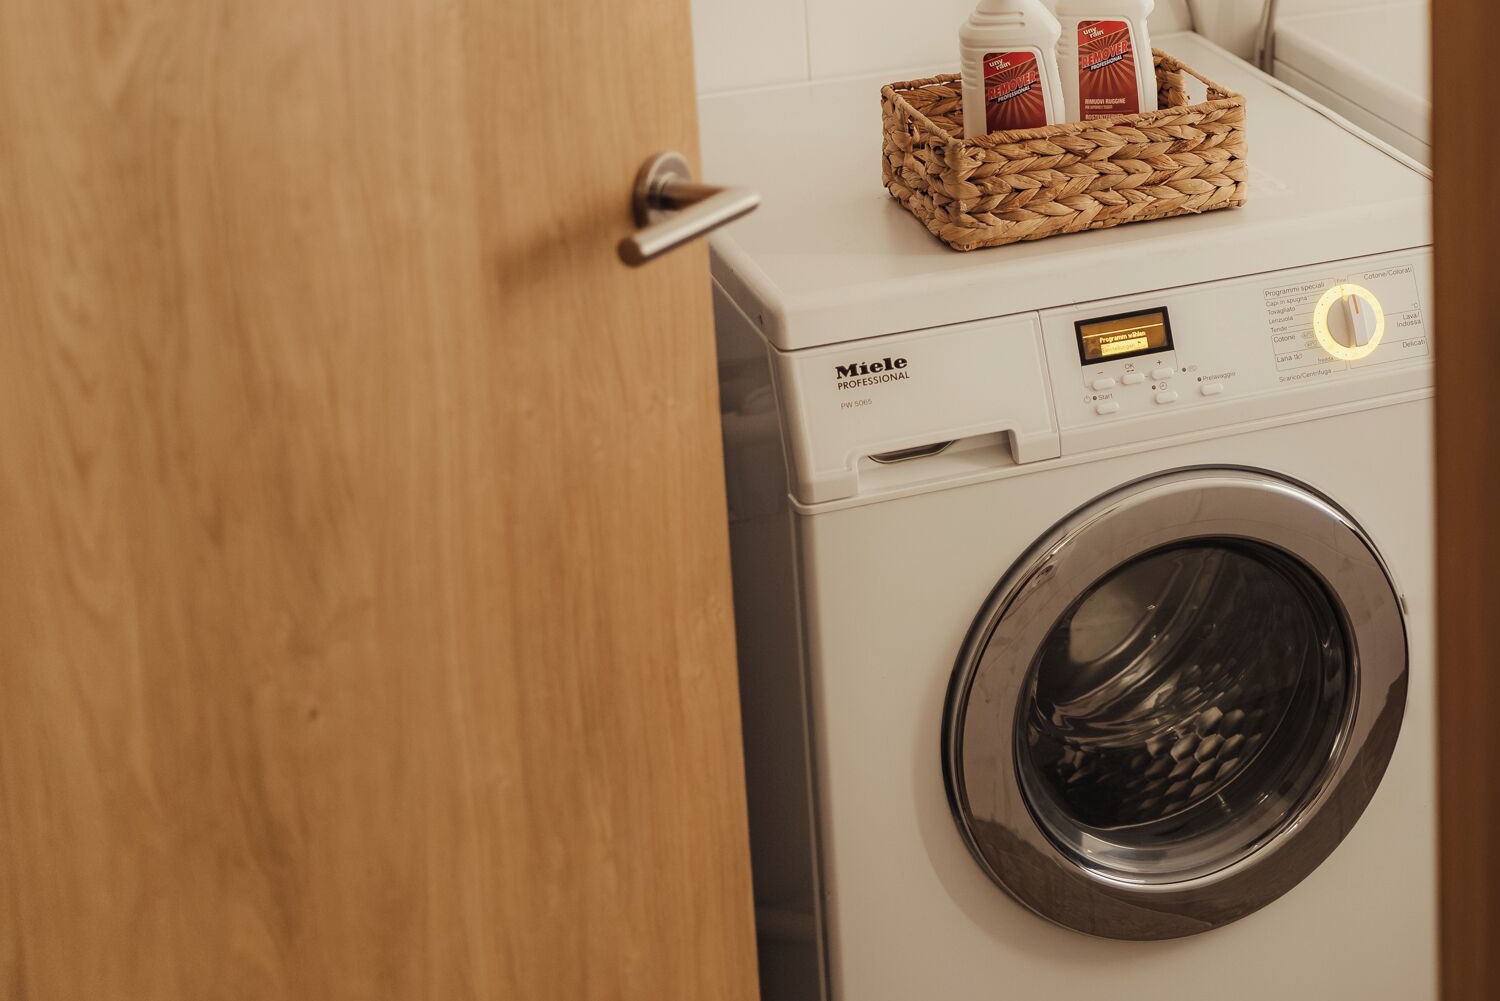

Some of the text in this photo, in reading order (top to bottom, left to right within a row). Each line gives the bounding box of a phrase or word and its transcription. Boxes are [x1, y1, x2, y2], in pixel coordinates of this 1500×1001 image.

[1081, 40, 1128, 67] REMOVER
[1090, 55, 1122, 70] PROFESSIONAL
[987, 71, 1037, 100] REMOVER
[998, 85, 1031, 103] PROFESSIONAL
[1363, 267, 1412, 280] Cotone/Colorati
[1264, 282, 1325, 298] Programmi speciali
[1100, 334, 1127, 343] Programm
[1273, 335, 1296, 343] Cotone
[1402, 339, 1426, 348] Delicati
[1276, 355, 1293, 363] Lana
[835, 357, 908, 379] Miele
[837, 371, 910, 390] PROFESSIONAL
[840, 401, 853, 409] PW
